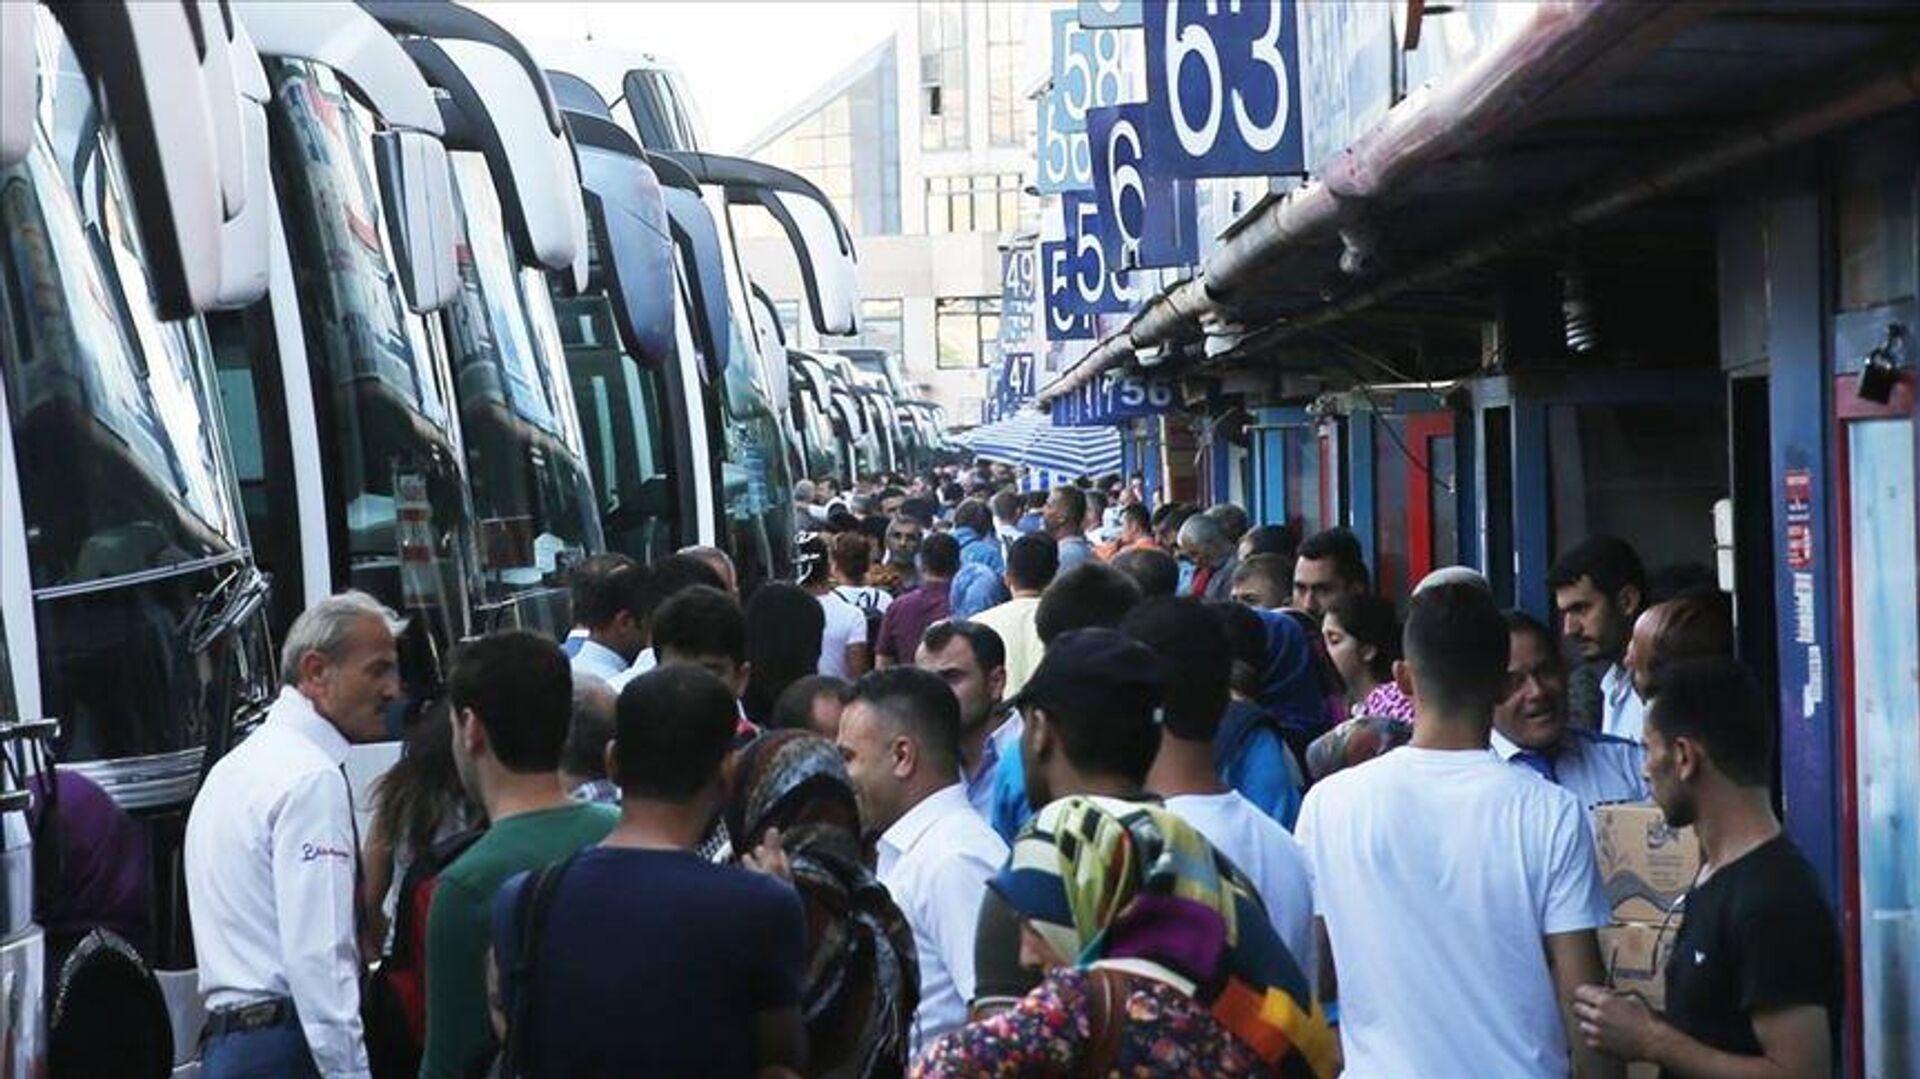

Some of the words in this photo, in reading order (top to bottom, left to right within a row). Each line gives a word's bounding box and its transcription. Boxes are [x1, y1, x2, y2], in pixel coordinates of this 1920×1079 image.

[1063, 20, 1120, 120] 58
[1165, 0, 1289, 157] 63
[1009, 356, 1033, 396] 47
[1120, 374, 1173, 407] 56
